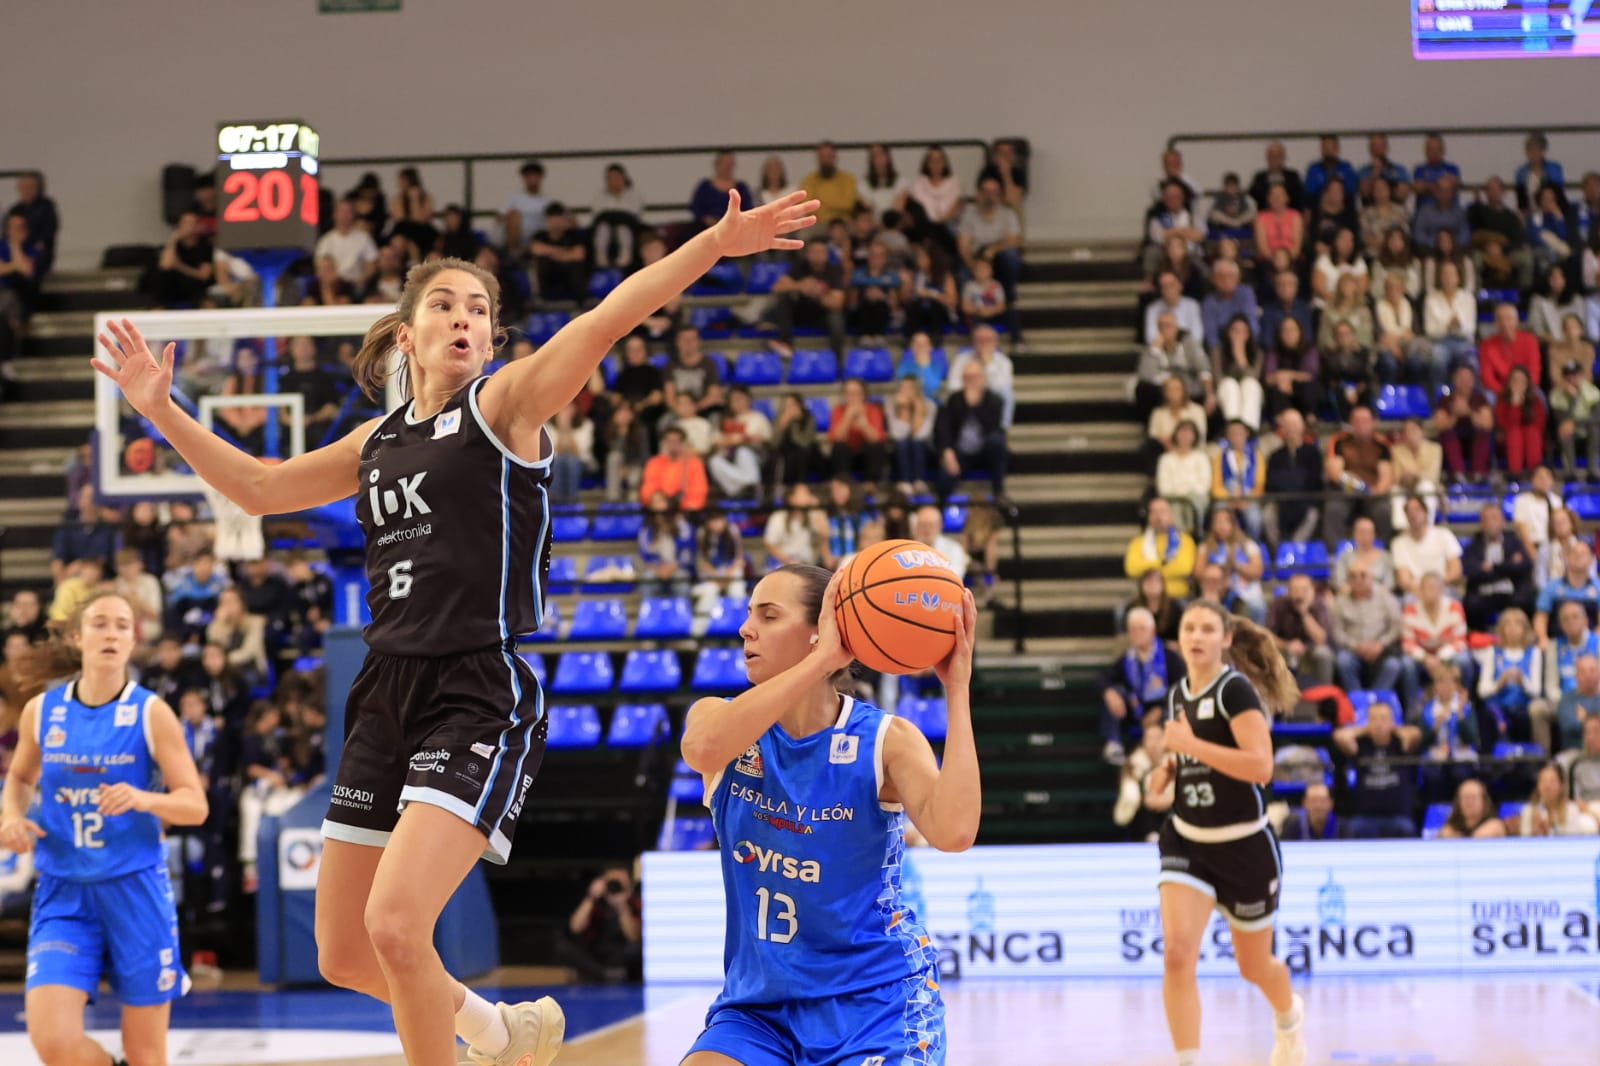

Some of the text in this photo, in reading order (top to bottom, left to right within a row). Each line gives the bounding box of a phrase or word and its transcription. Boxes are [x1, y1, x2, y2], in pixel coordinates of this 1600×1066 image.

[218, 123, 300, 153] 07:17
[223, 169, 295, 222] 20
[377, 522, 432, 546] elektronika
[387, 559, 414, 600] 6
[342, 799, 373, 811] COUNTRY
[1183, 782, 1216, 807] 33
[796, 804, 807, 822] Y
[811, 802, 854, 821] LEÓN
[71, 811, 105, 848] 12
[755, 886, 799, 944] 13
